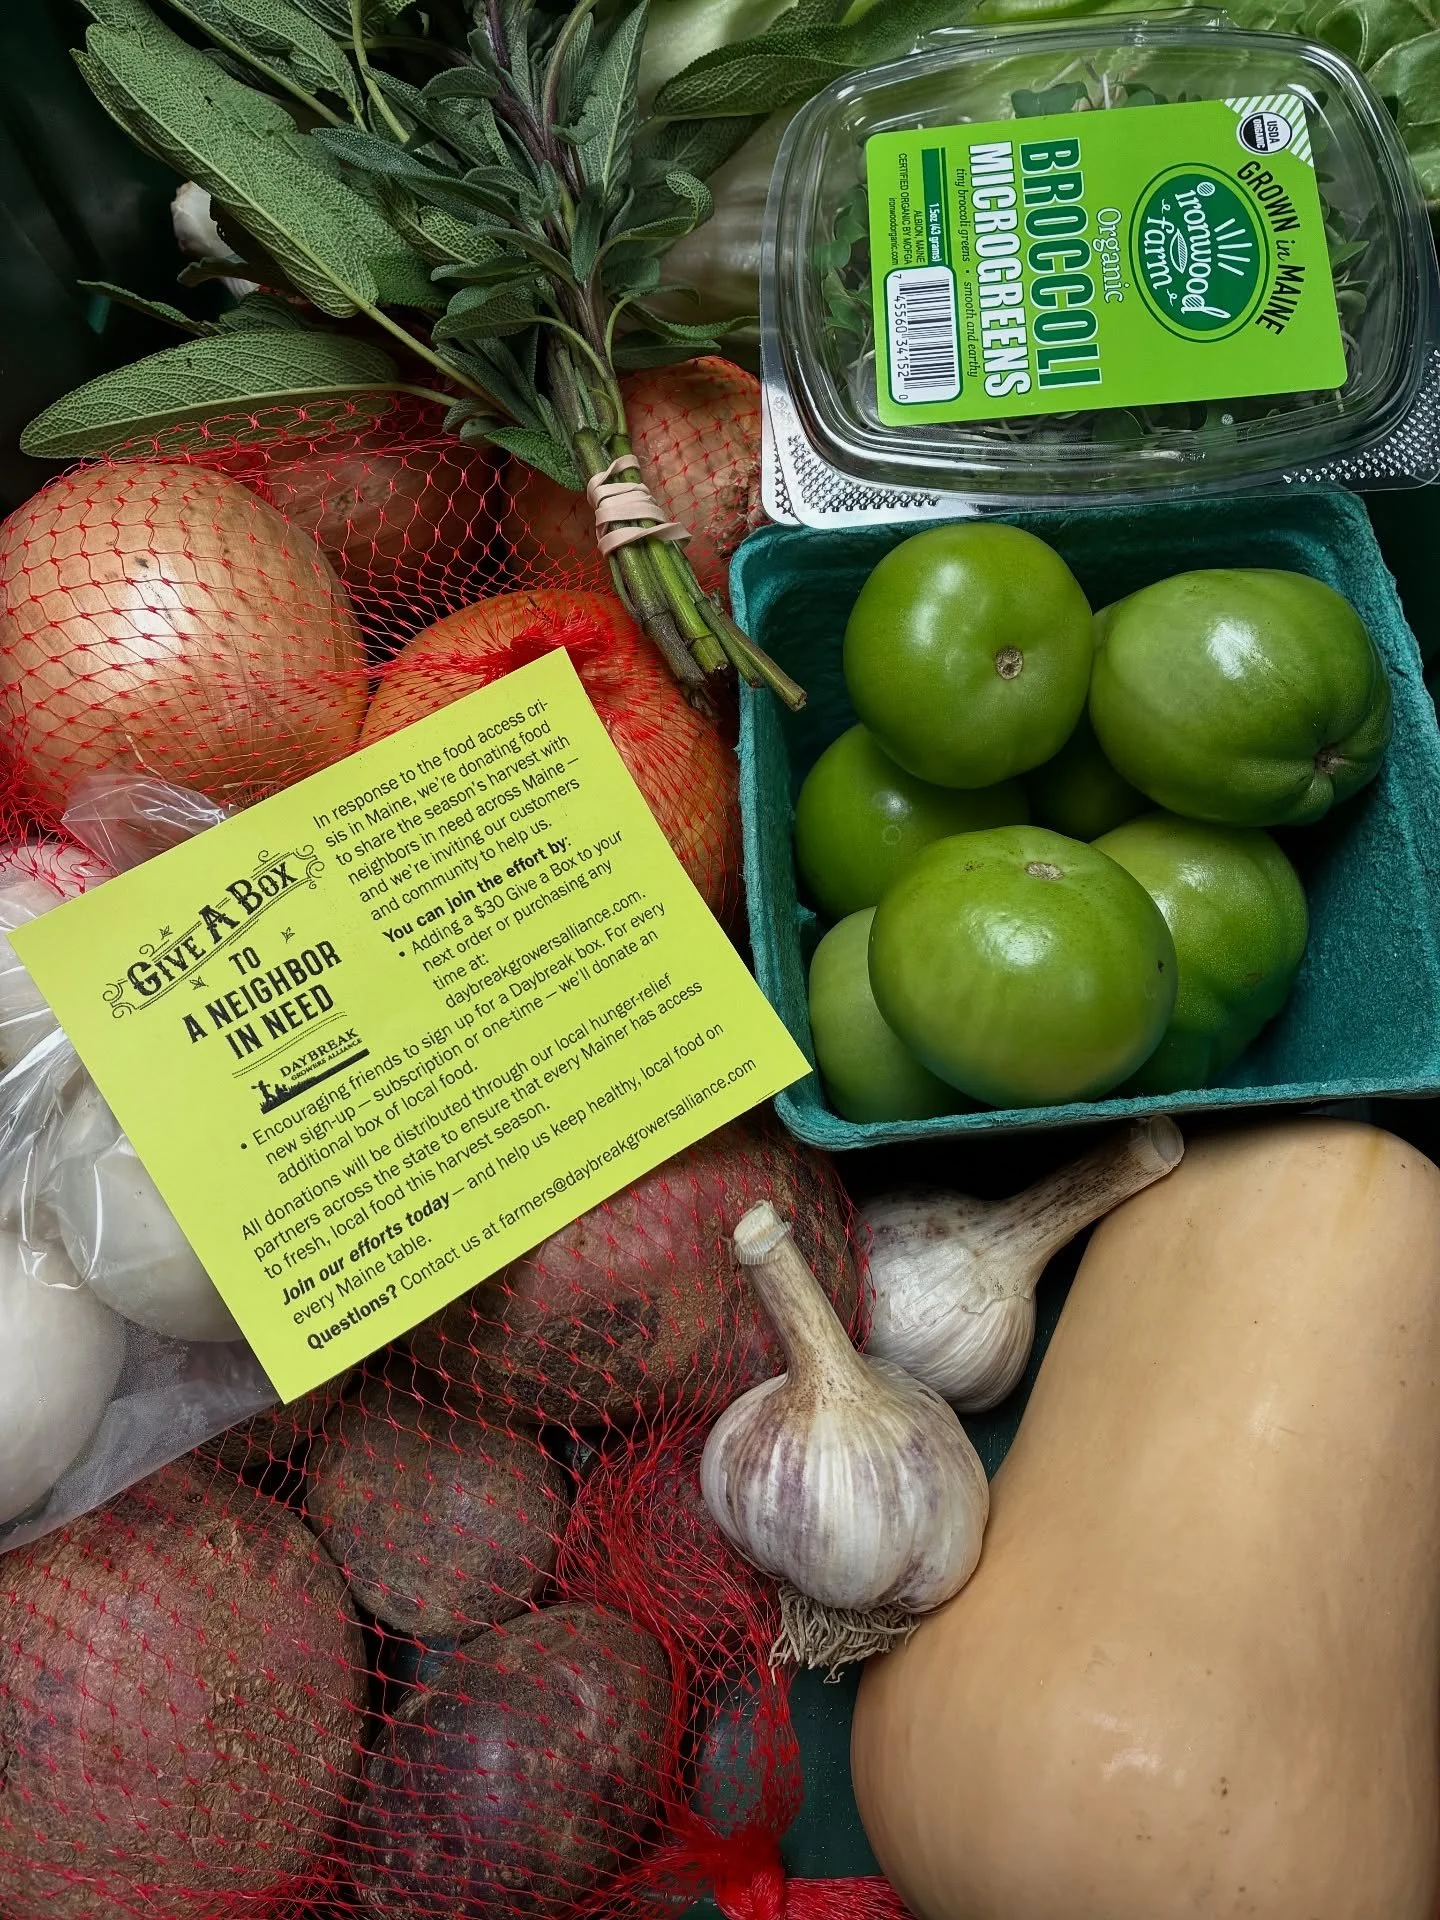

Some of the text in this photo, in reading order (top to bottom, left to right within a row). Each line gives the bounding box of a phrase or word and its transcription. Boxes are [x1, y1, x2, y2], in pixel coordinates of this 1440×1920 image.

[1252, 118, 1266, 150] ORGANIC
[1266, 120, 1280, 144] USDA
[888, 197, 899, 265] ironwoodorganic.com
[899, 153, 912, 265] CERTIFIED ORGANIC BY MOFGA
[914, 210, 925, 263] ALBION, MAINE
[929, 203, 942, 262] 1.5oz (43 grams)
[1019, 137, 1102, 390] BROCCOLI
[1091, 208, 1130, 303] Organic
[1143, 216, 1174, 290] farm
[1175, 181, 1231, 319] ironwood
[1237, 161, 1306, 336] GROWN in MAINE
[893, 295, 908, 333] 45560
[955, 168, 981, 377] tiny broccoli greens smooth and earthy
[968, 140, 1032, 398] MICROGREENS
[896, 339, 909, 378] 34152
[313, 698, 548, 829] In response to the food access cri-
[325, 719, 551, 848] sis in Maine, we’re donating food
[335, 735, 571, 866] to share the season’s harvest with
[359, 779, 580, 903] and we’re inviting our customers
[371, 819, 552, 921] and community to help us.
[381, 836, 572, 943] You can join the effort by:
[412, 830, 622, 955] Adding a $30 Give a Box to your
[127, 861, 299, 997] GIVE A BOX
[228, 947, 262, 976] TO
[422, 860, 612, 972] next order or purchasing any
[433, 953, 489, 990] time at:
[445, 891, 646, 1008] daybreakgrowersalliance.com.
[182, 941, 343, 1044] A NEIGHBOR
[225, 984, 334, 1060] IN NEED
[252, 902, 665, 1146] Encouraging friends to sign up for a Daybreak box. For every
[242, 972, 672, 1241] All donations will be distributed through our local hunger-relief
[280, 1028, 359, 1078] DAYBREAK
[291, 1038, 363, 1081] GROWERS ALLIANCE
[253, 982, 703, 1263] partners across the state to ensure that every Mainer has access
[283, 1277, 316, 1306] Join
[319, 1256, 345, 1282] our
[349, 1222, 403, 1262] efforts
[466, 1162, 497, 1189] and
[495, 1144, 530, 1170] help
[531, 1132, 551, 1149] us
[549, 1109, 587, 1136] keep
[586, 1076, 642, 1113] healthy,
[640, 1051, 674, 1080] local
[673, 1032, 705, 1059] food
[706, 1024, 724, 1040] on
[264, 1102, 550, 1279] to fresh, local food this harvest season.
[307, 1059, 756, 1350] Questions? Contact us at farmers@daybreakgrowersalliance.com
[293, 1235, 432, 1325] every Maine table.
